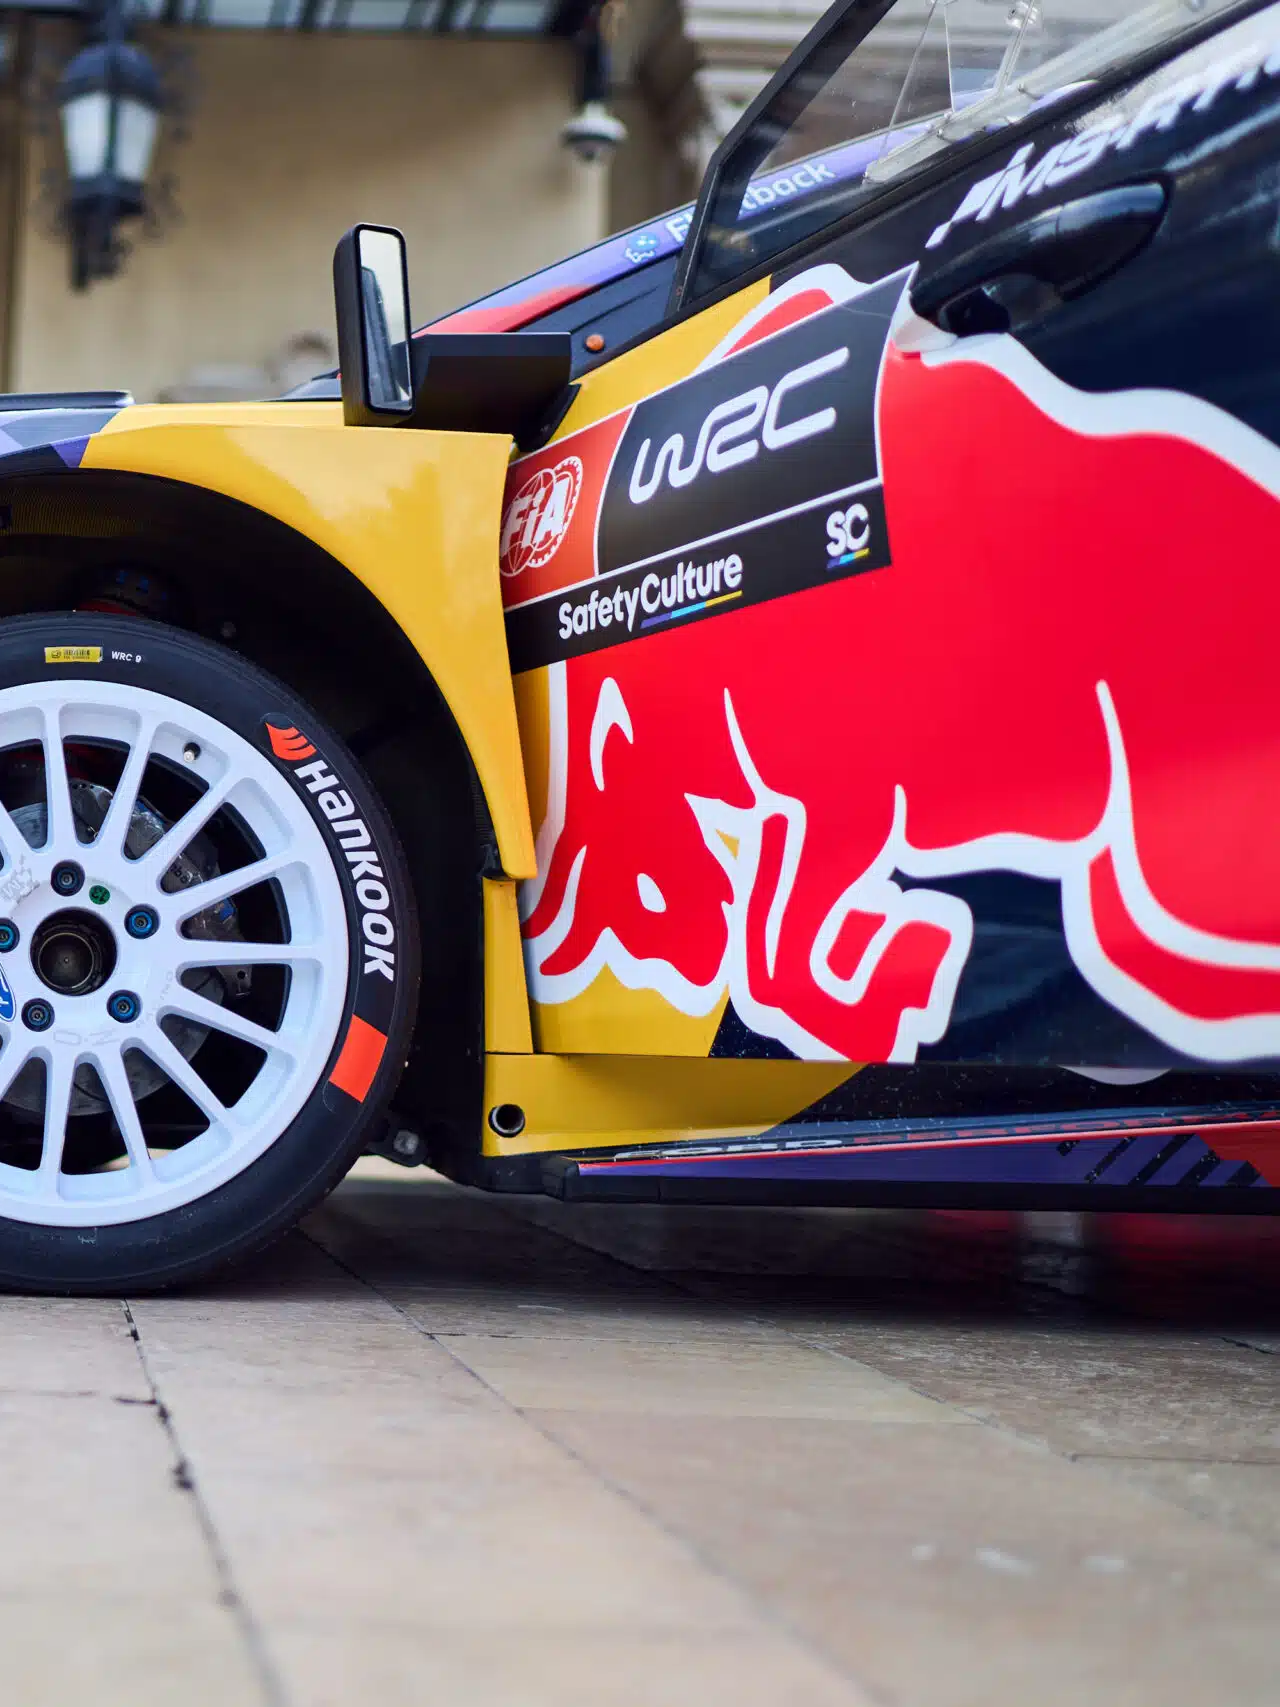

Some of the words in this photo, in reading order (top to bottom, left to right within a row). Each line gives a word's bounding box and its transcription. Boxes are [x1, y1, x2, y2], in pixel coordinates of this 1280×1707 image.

[629, 346, 849, 504] WRC
[826, 503, 870, 557] SC
[558, 553, 743, 639] SafetyCulture
[111, 650, 133, 662] WRC
[613, 1138, 843, 1159] FORD
